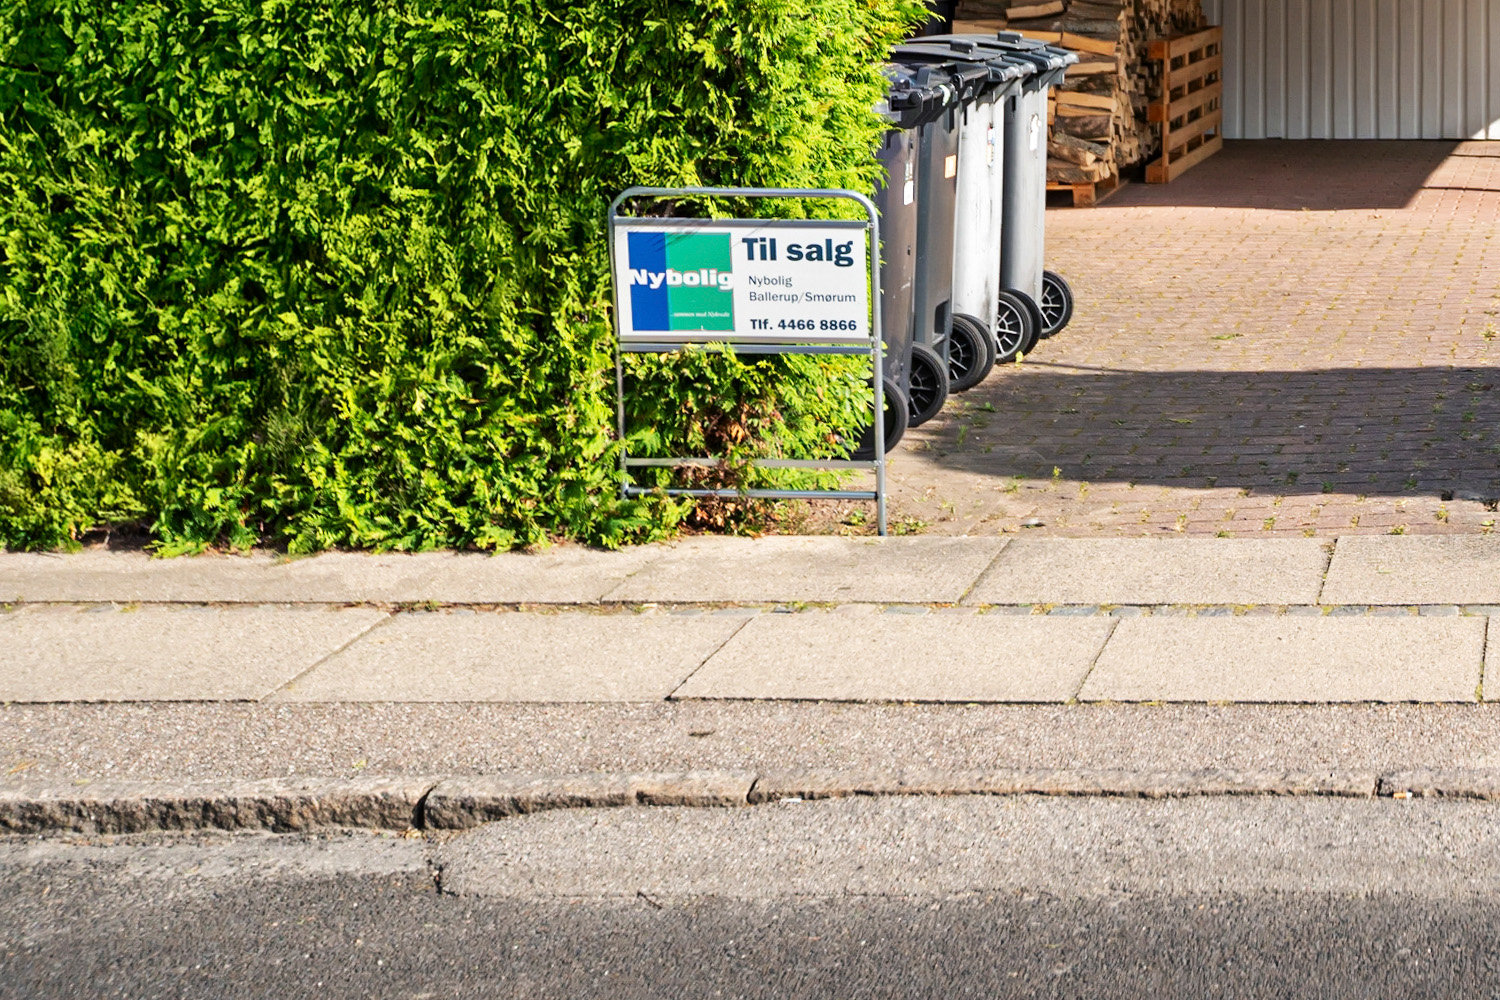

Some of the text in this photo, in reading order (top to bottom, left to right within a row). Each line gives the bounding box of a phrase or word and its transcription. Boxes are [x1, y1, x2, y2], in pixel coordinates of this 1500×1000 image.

[741, 237, 854, 268] Til salg
[629, 268, 734, 291] Nybolig
[748, 275, 793, 288] Nybolig
[749, 291, 856, 304] Ballerup/Smørum
[750, 318, 857, 331] Tlf. 4466 8866
